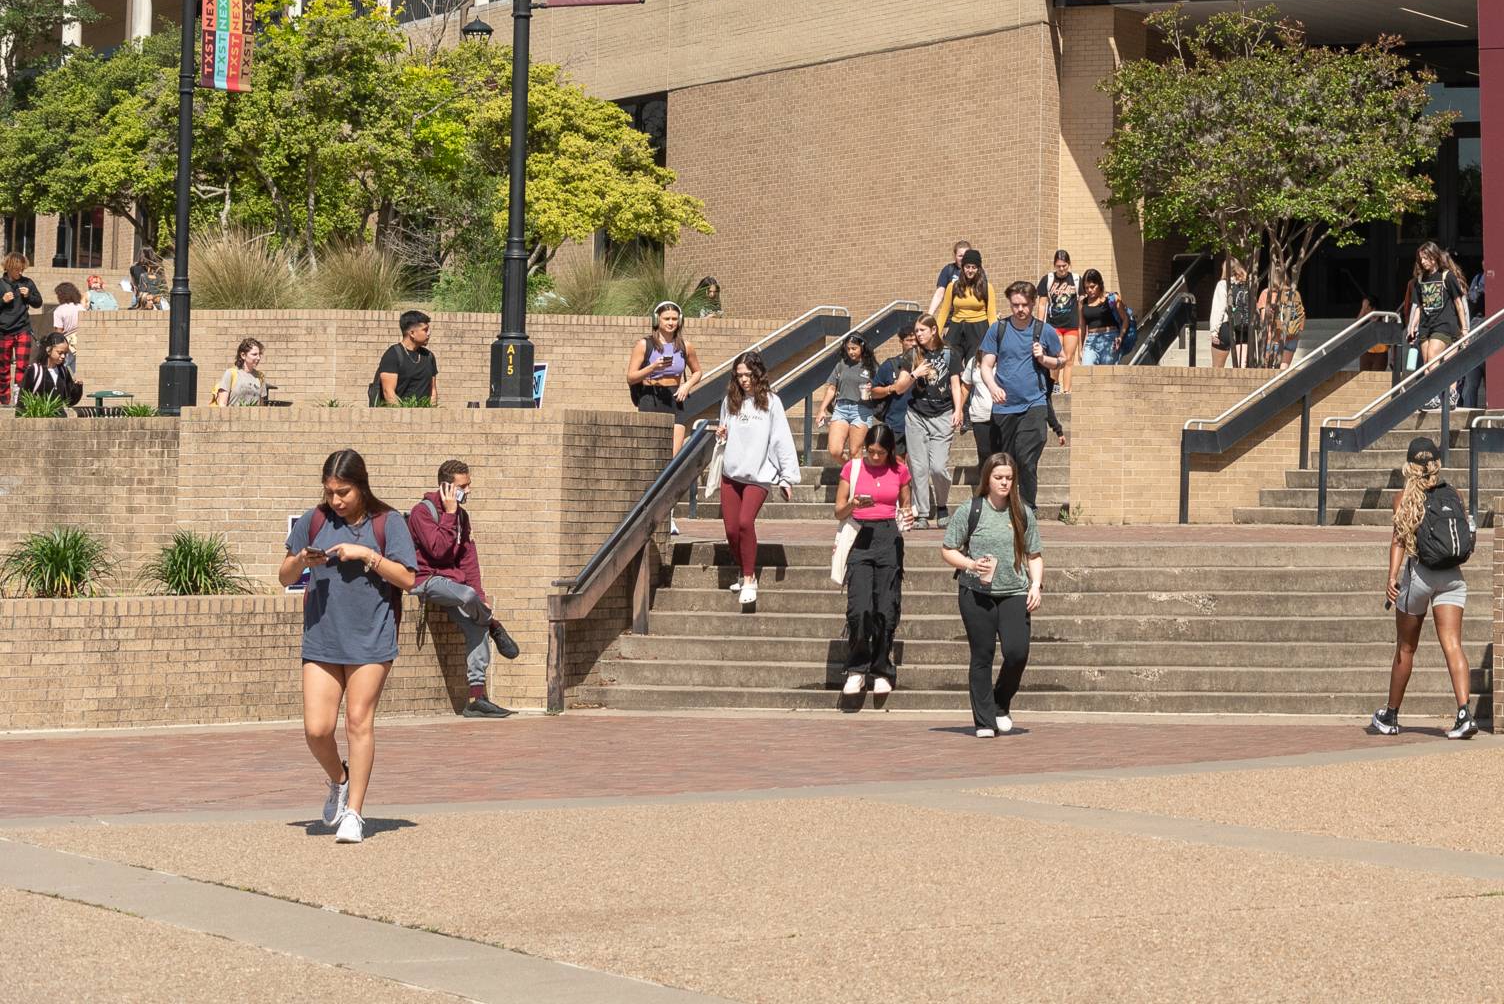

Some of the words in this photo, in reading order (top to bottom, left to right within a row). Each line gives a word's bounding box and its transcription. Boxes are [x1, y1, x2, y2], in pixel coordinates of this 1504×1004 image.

[204, 33, 214, 75] TXST
[218, 34, 227, 76] TXST
[230, 35, 240, 77] TXST
[242, 37, 252, 79] TXST
[507, 344, 515, 375] A15
